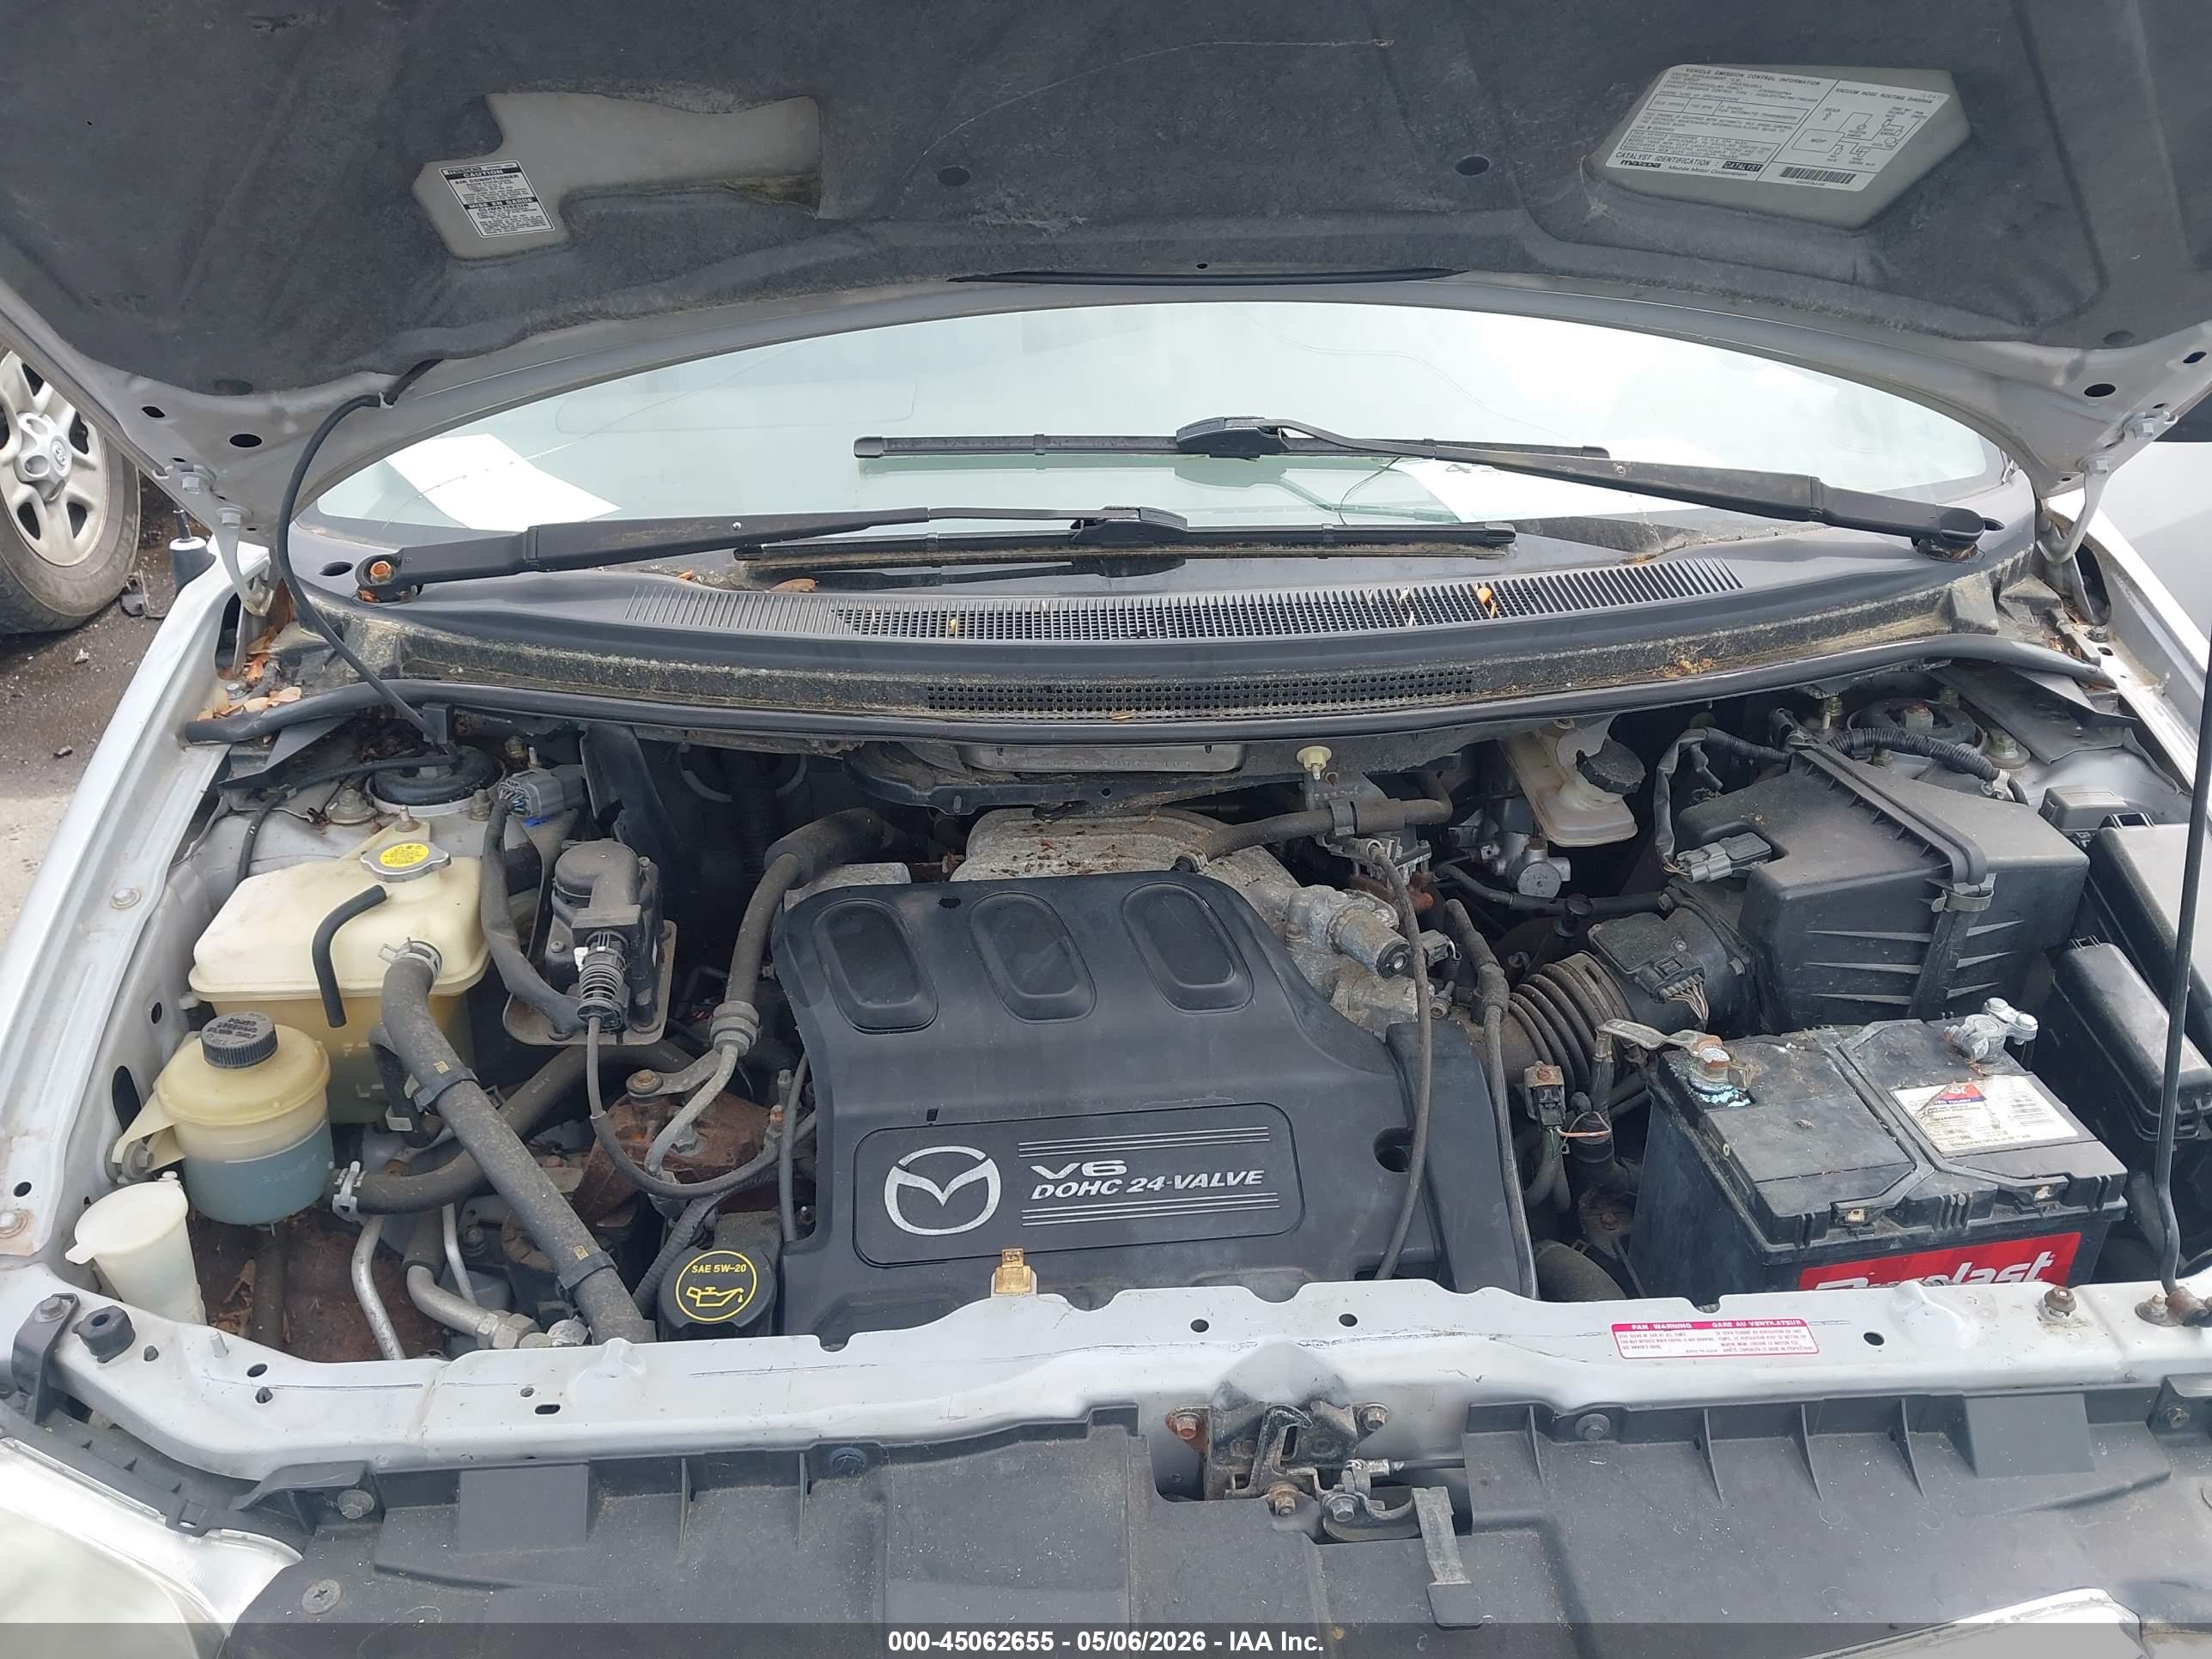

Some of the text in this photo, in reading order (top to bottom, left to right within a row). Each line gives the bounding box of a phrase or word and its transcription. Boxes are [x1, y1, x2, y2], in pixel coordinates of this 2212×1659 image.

[1715, 70, 1744, 78] EMISSION
[1779, 76, 1820, 86] INFORMATION
[1615, 151, 1652, 161] CATALYST
[1655, 155, 1711, 167] IDENTIFICATION
[1724, 161, 1762, 171] CATALYST
[463, 169, 504, 178] CAUTION
[469, 174, 520, 183] CONDITIONER
[478, 204, 530, 212] CLIMATISEUR
[1030, 1159, 1127, 1180] V6
[1030, 1170, 1265, 1200] DOHC 24-VALVE
[691, 1263, 747, 1273] SAE 5W-20
[1815, 1251, 2054, 1290] alast
